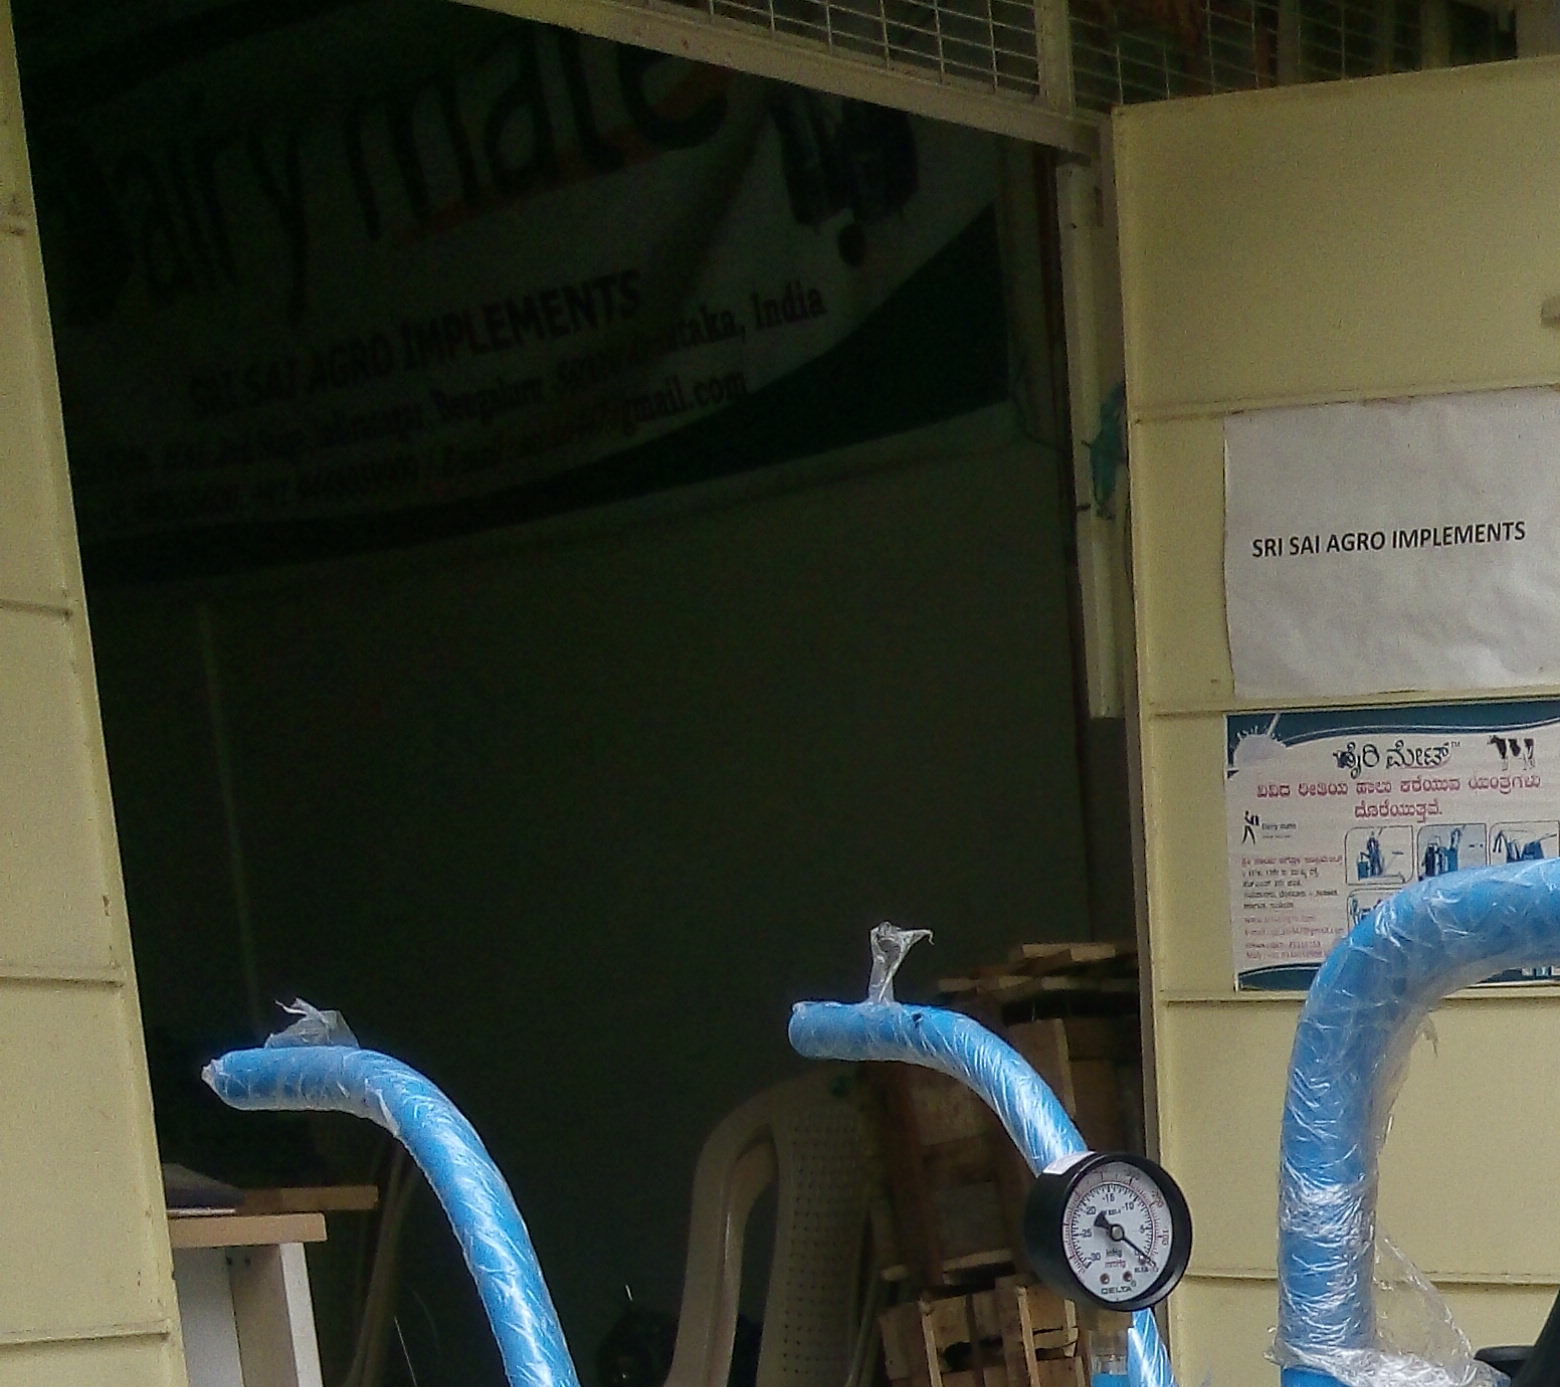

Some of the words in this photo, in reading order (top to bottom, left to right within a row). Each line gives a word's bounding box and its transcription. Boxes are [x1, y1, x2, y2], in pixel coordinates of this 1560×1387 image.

[752, 279, 827, 330] India
[305, 334, 396, 393] AGRO
[402, 269, 640, 370] IMPLEMENTS
[1252, 538, 1283, 557] SRI
[1289, 535, 1320, 555] SAI
[1326, 531, 1385, 553] AGRO
[1392, 521, 1526, 549] IMPLEMENTS
